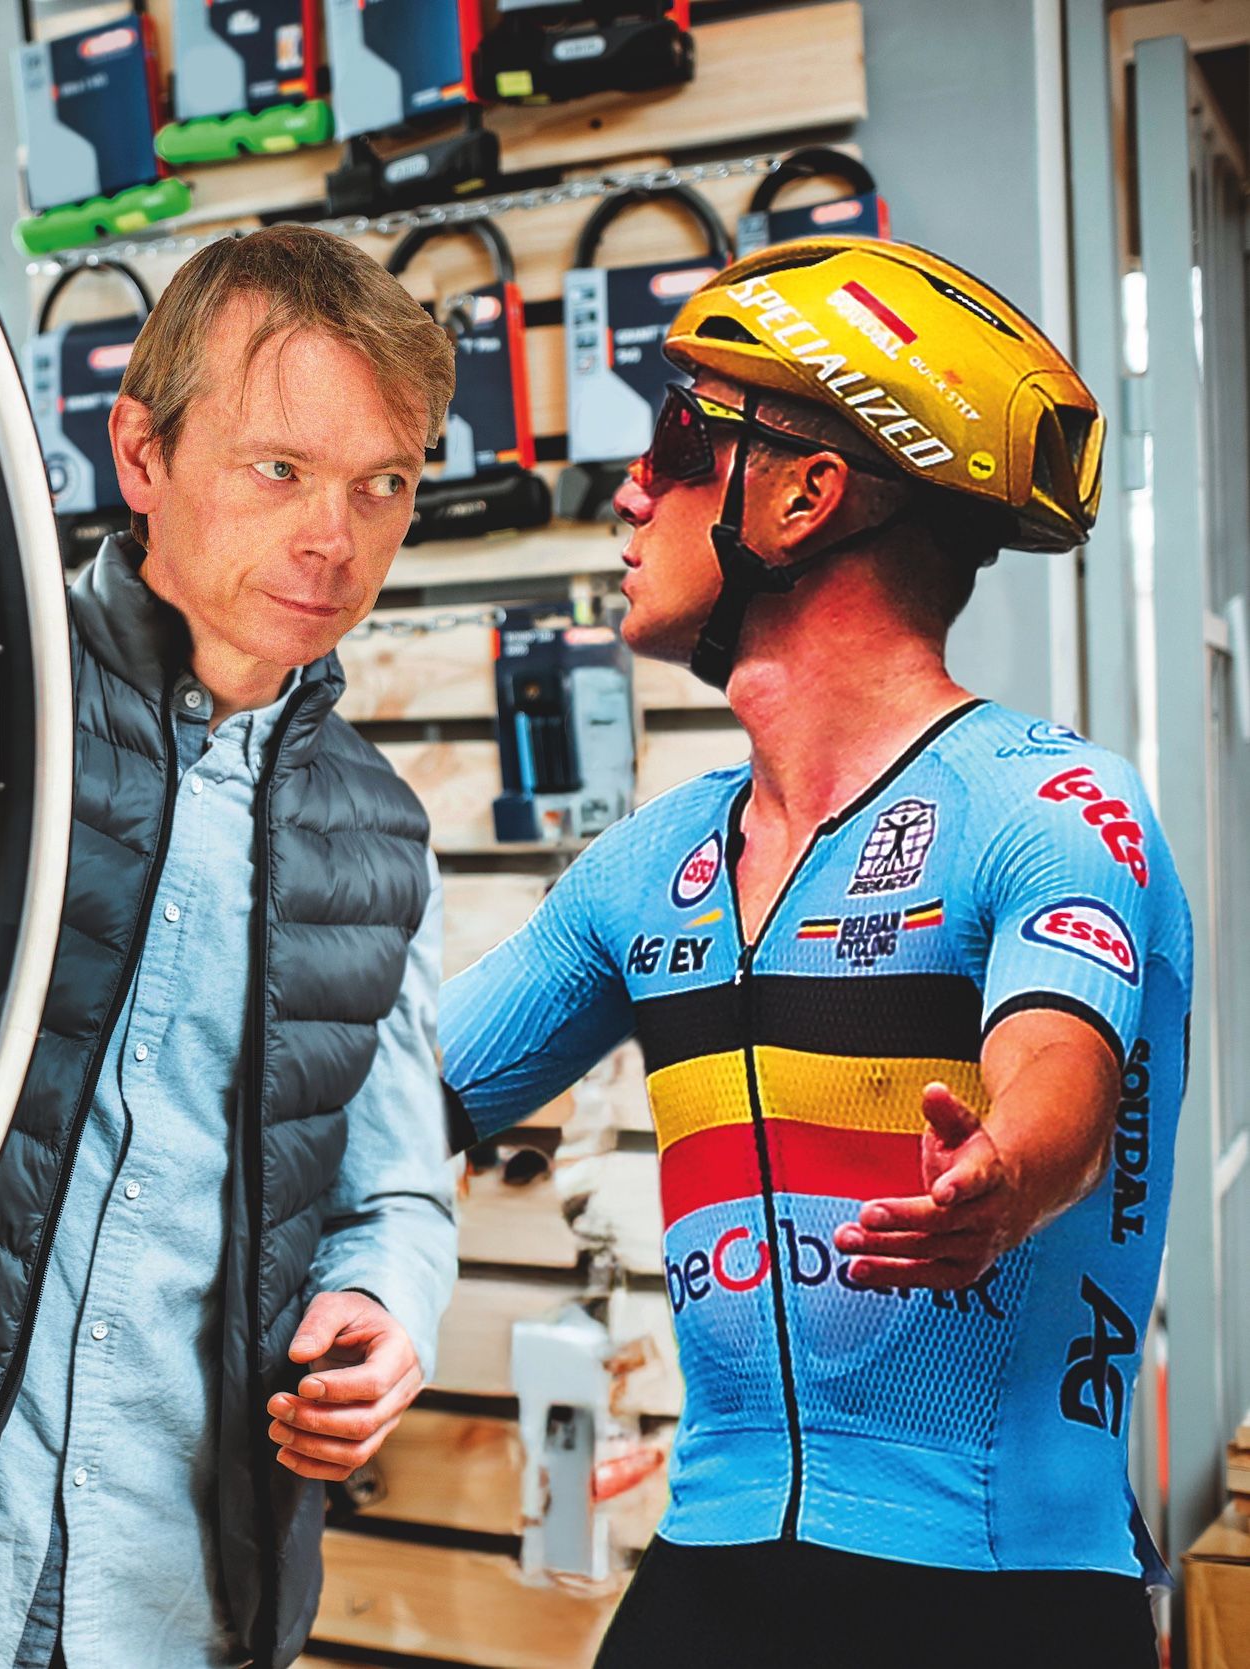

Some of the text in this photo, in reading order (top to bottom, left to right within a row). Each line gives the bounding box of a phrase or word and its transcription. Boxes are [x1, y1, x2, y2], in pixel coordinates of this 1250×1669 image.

[726, 279, 955, 468] SPECIALIZED
[668, 937, 713, 974] EY
[1111, 1037, 1150, 1245] SOUDAL
